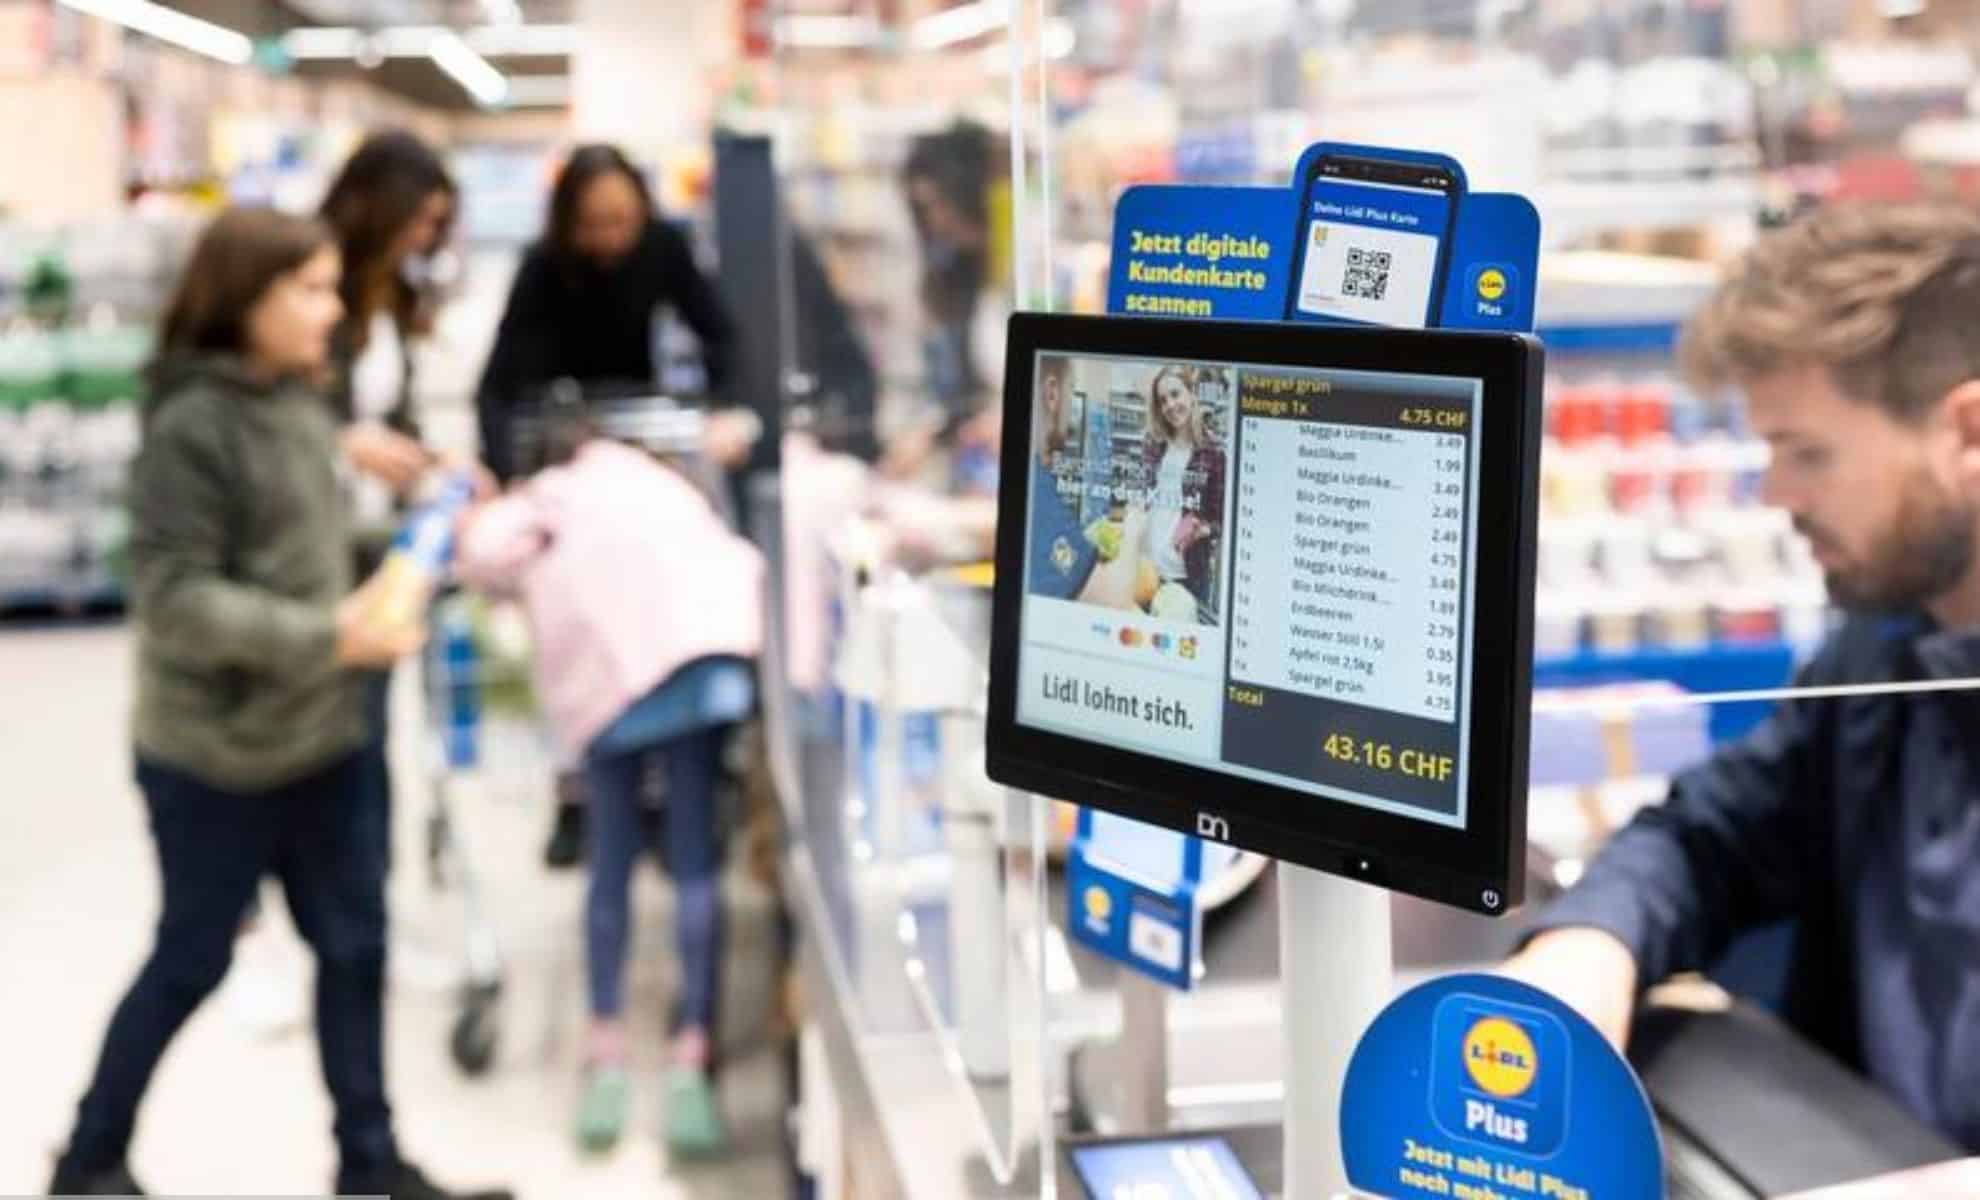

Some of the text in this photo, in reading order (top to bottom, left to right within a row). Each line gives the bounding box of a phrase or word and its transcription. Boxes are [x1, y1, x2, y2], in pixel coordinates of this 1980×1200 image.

[1314, 202, 1419, 226] Deine Lidl Plus Karte
[1131, 231, 1270, 261] Jetzt digitale
[1129, 260, 1266, 290] Kundenkarte
[1126, 294, 1212, 316] scannen
[1478, 302, 1502, 316] Plus
[1242, 373, 1331, 395] Spargel grün
[1242, 397, 1466, 428] Menge 1x 4.75 CHF
[1299, 445, 1357, 461] Basilikum
[1434, 459, 1460, 473] 1.99
[1296, 489, 1314, 503] Bio
[1317, 494, 1370, 512] Orangen
[1432, 506, 1458, 519] 2.49
[1295, 512, 1313, 525] Bio
[1316, 516, 1370, 534] Orangen
[1432, 529, 1457, 543] 2.49
[1294, 535, 1338, 554] Spargel
[1341, 540, 1370, 555] grün
[1431, 554, 1456, 568] 4.75
[1292, 579, 1312, 593] Bio
[1291, 601, 1353, 621] Erdbeeren
[1428, 623, 1454, 638] 2.79
[1290, 624, 1334, 642] Wasser
[1426, 648, 1453, 663] 0.35
[1322, 653, 1341, 666] rot
[1426, 670, 1452, 686] 3.95
[1042, 672, 1193, 731] Lidl lohnt sich.
[1229, 686, 1263, 707] Total
[1289, 669, 1333, 688] Spargel
[1335, 678, 1363, 695] grün
[1424, 695, 1450, 710] 4.75
[1324, 733, 1453, 781] 43.16 CHF
[1466, 1099, 1528, 1143] Plus
[1400, 1166, 1449, 1196] noch
[1404, 1138, 1589, 1200] Jetzt mit Lidl Plus
